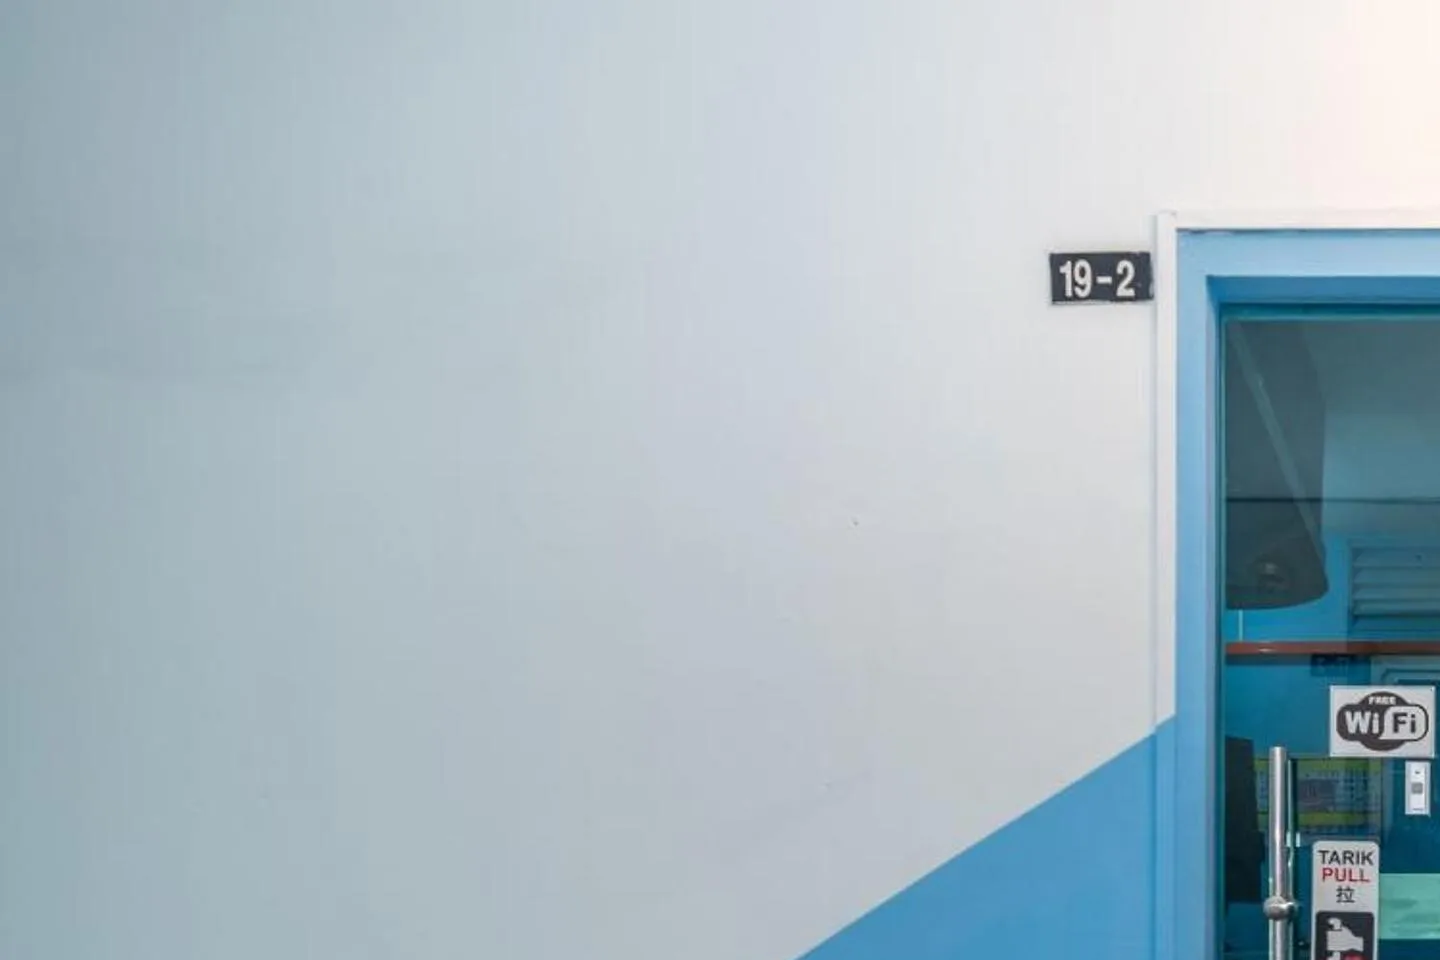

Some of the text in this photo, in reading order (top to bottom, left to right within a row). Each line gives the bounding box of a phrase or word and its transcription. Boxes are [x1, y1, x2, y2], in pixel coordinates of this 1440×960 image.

[1059, 259, 1136, 298] 19-2
[1368, 695, 1397, 706] FREE
[1318, 850, 1375, 866] TARIK
[1321, 867, 1370, 883] PULL
[1336, 886, 1355, 904] 拉
